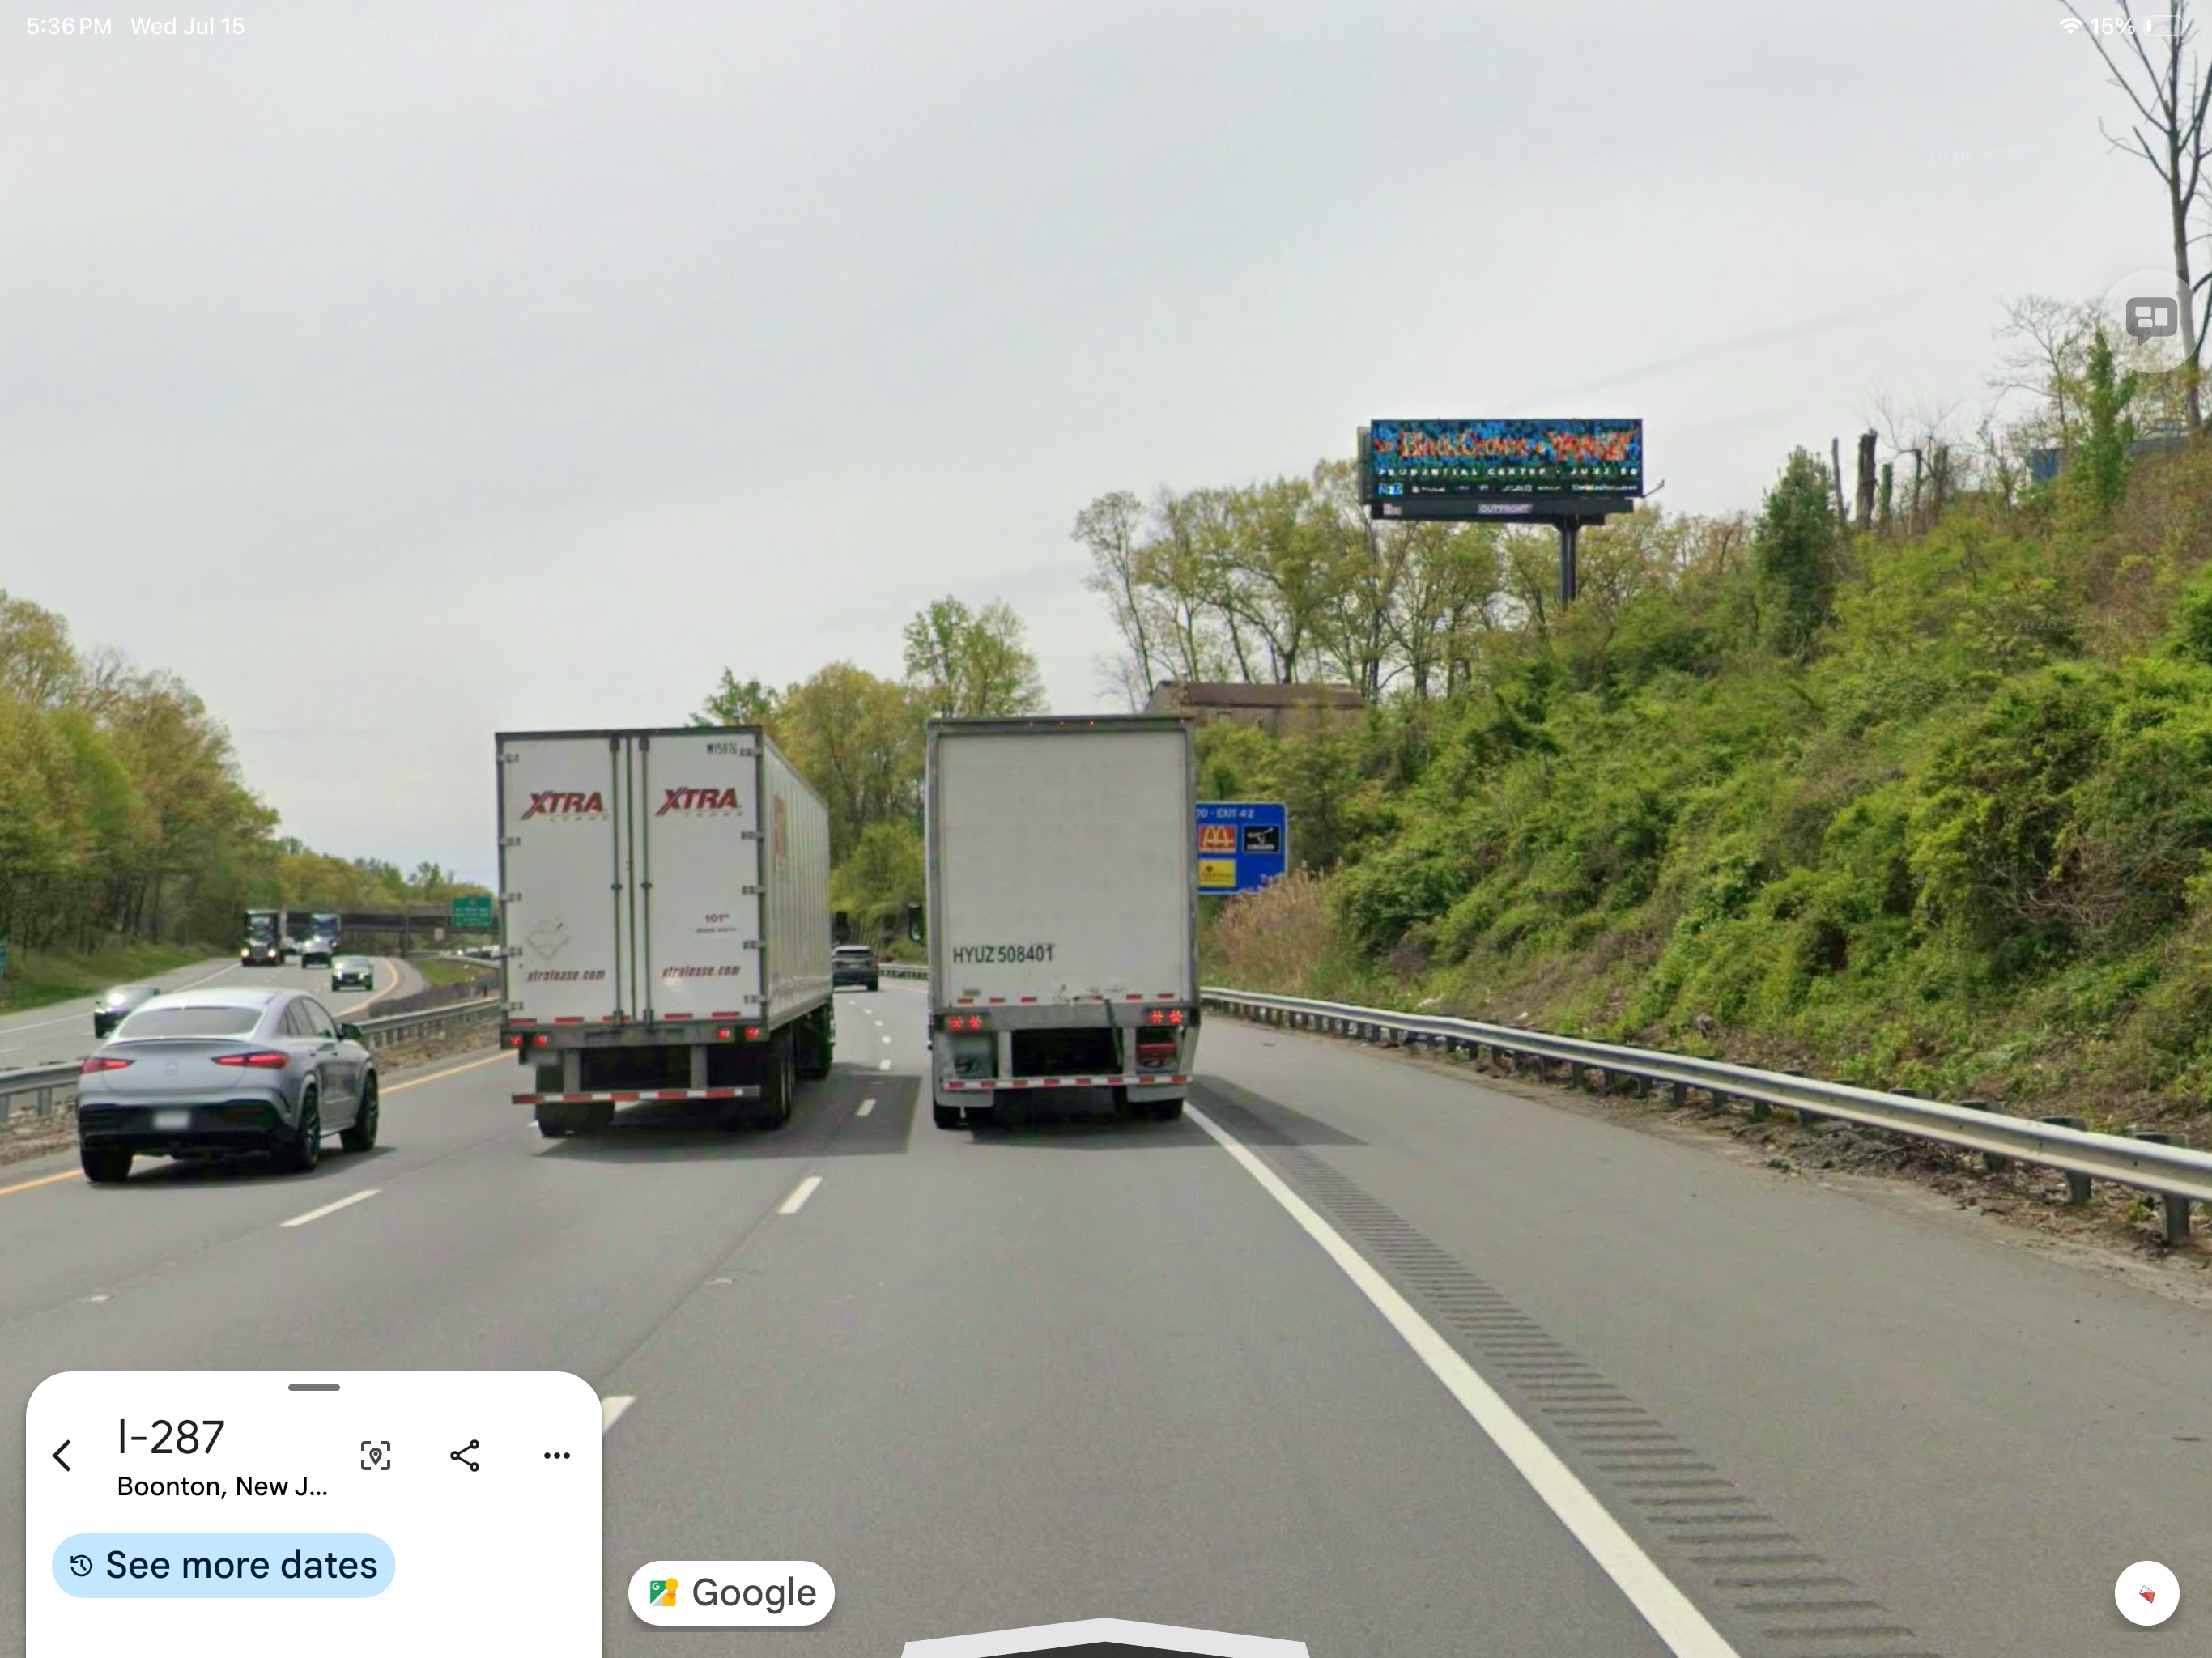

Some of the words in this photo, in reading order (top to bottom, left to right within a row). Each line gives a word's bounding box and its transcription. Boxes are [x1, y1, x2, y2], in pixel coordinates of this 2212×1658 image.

[521, 791, 603, 820] XTRA
[654, 787, 738, 816] XTRA
[953, 946, 994, 963] HYUZ
[998, 944, 1053, 963] 508401
